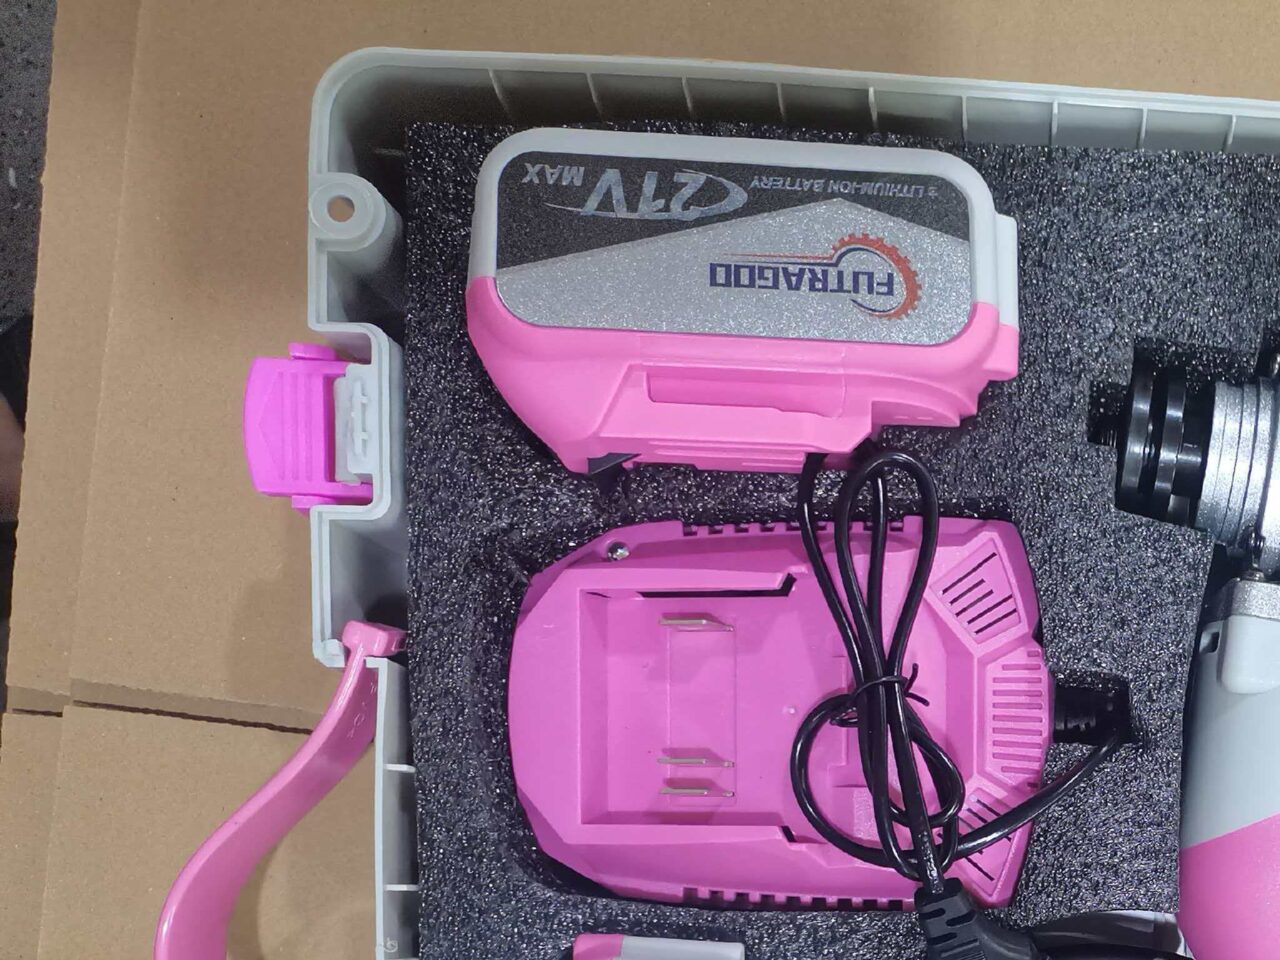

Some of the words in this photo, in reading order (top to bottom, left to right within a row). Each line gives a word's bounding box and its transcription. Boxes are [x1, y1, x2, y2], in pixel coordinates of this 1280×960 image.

[521, 162, 585, 187] MAX
[750, 173, 826, 193] BATTERY
[580, 167, 707, 222] 21V
[708, 262, 895, 297] FUTRAGOO
